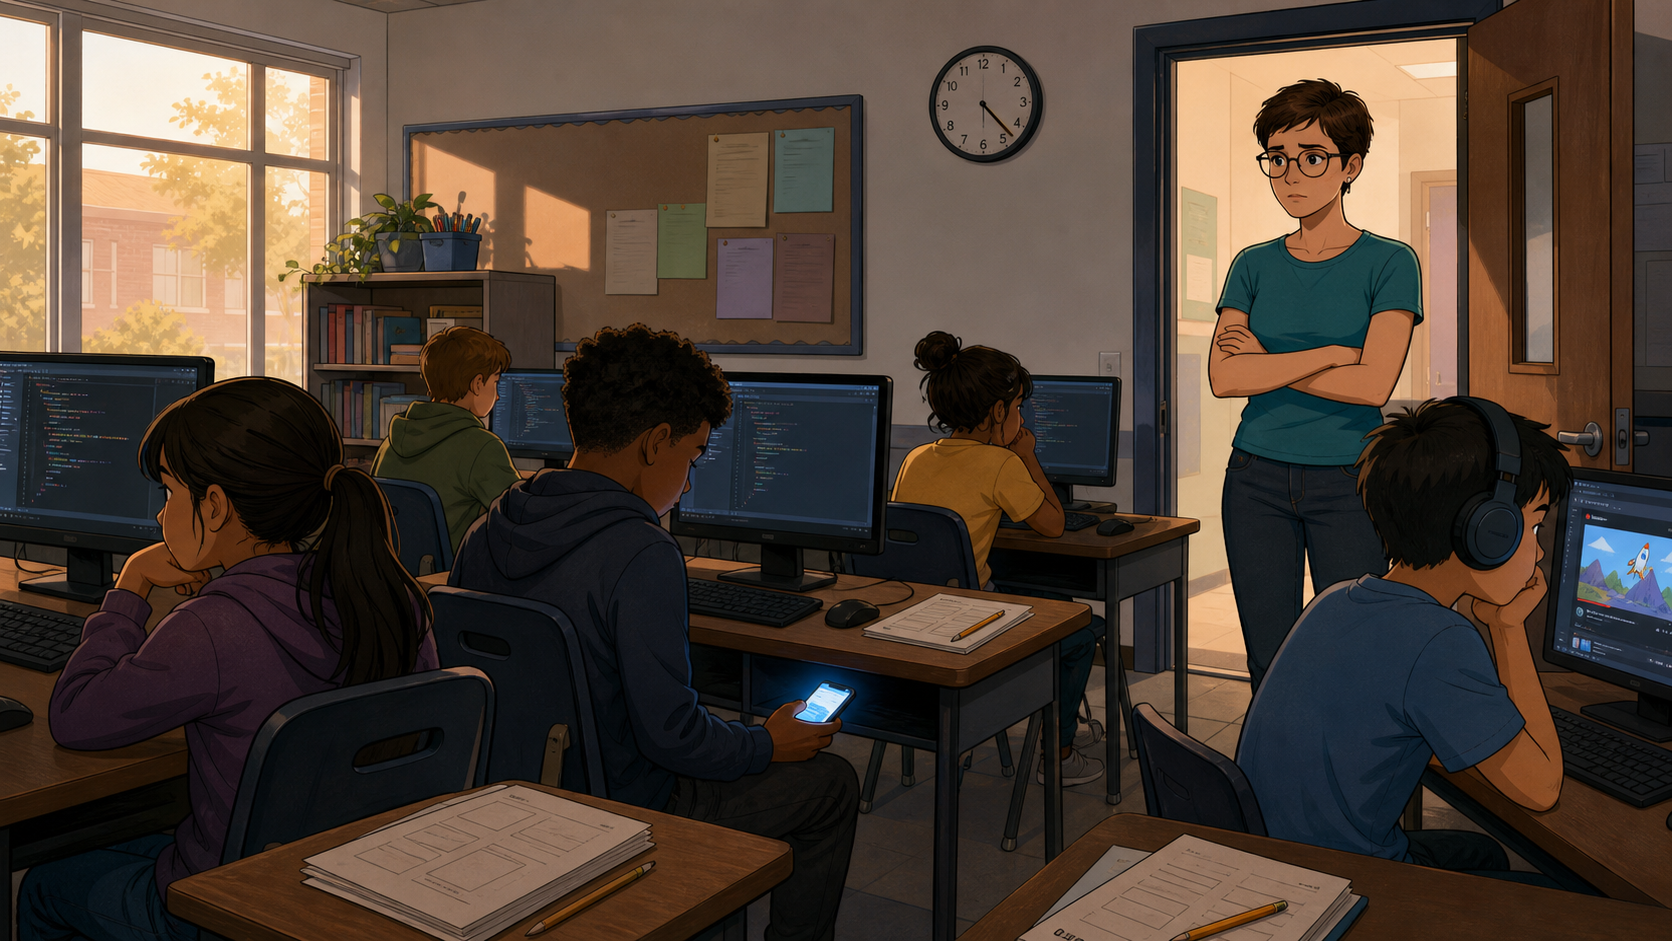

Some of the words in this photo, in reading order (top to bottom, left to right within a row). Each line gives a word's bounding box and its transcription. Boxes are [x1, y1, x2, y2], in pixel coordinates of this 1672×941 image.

[978, 59, 989, 69] 12
[1001, 63, 1005, 73] 1
[960, 66, 968, 76] 11
[947, 81, 957, 91] 10
[1014, 77, 1020, 87] 2
[942, 100, 948, 110] 9
[1020, 97, 1027, 107] 3
[947, 120, 954, 130] 8
[1014, 118, 1020, 128] 4
[961, 135, 968, 144] 7
[1000, 134, 1006, 143] 5
[980, 139, 987, 149] 6
